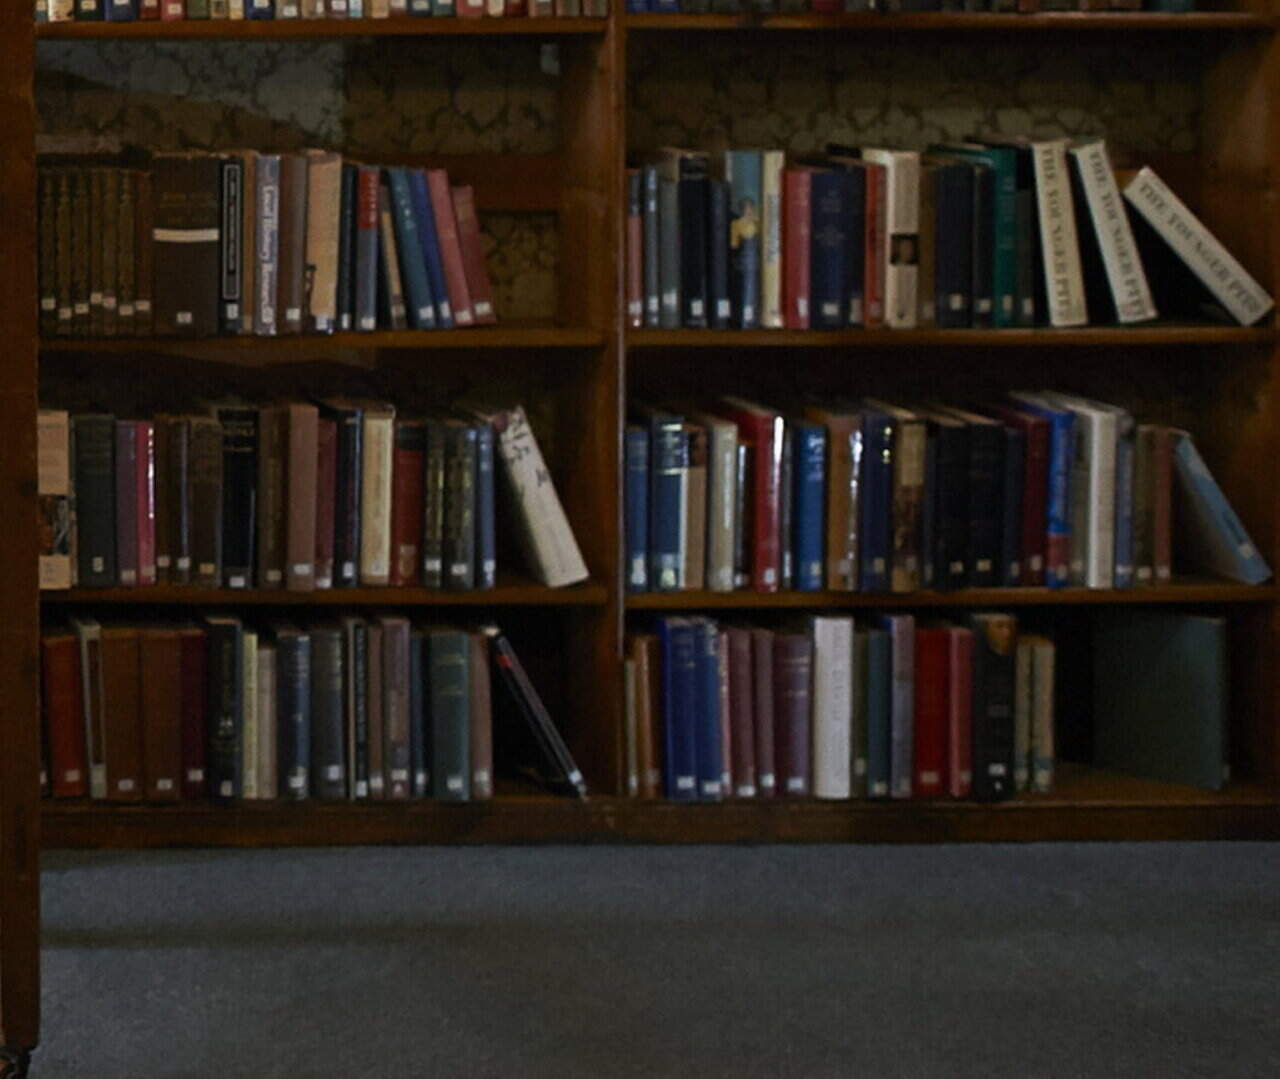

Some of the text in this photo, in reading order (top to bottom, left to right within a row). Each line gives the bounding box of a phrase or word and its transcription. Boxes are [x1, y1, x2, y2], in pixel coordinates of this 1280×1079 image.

[1041, 148, 1057, 182] THE
[1045, 188, 1067, 274] YOUNGER
[1088, 150, 1107, 188] THE
[1100, 193, 1132, 277] YOUNGER
[1138, 182, 1167, 218] THE
[1168, 212, 1232, 283] YOUNGER
